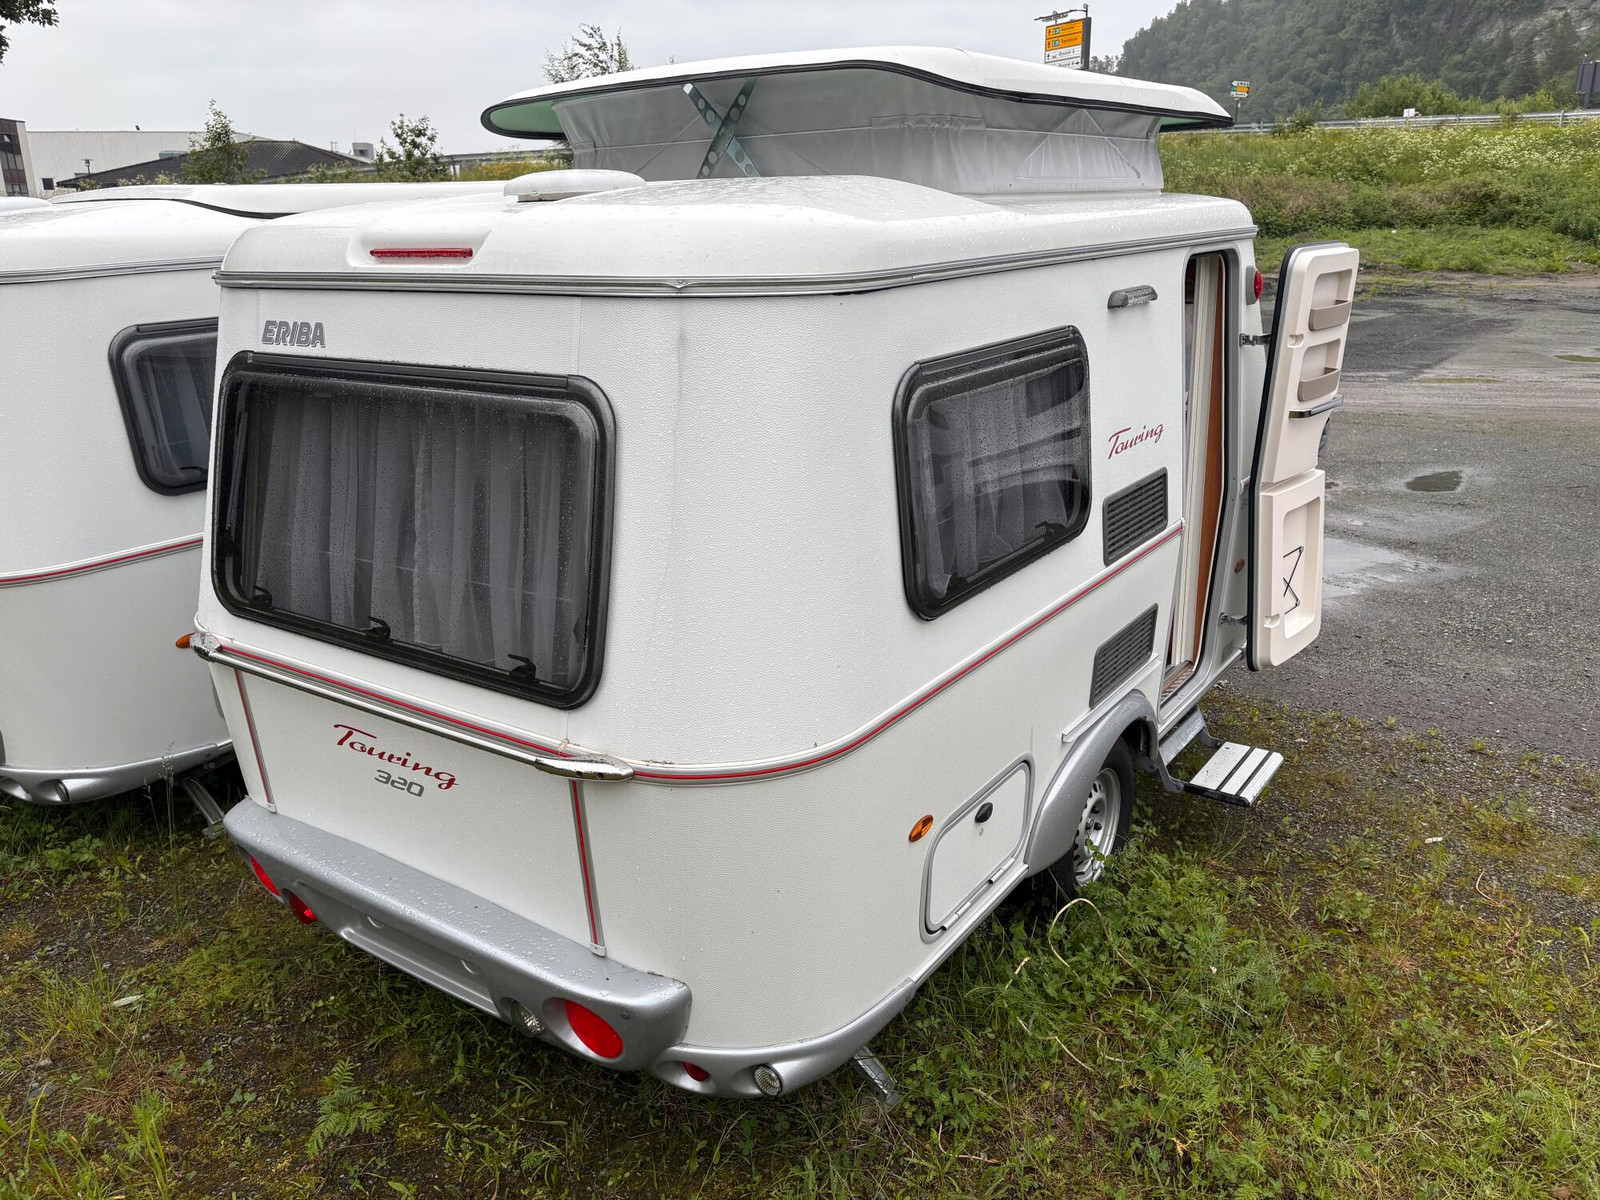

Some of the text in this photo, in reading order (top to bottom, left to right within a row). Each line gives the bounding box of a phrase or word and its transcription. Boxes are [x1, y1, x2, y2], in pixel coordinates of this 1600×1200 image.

[261, 320, 326, 348] ERIBA
[1108, 424, 1164, 459] Touring
[333, 724, 459, 790] Touring
[374, 769, 425, 798] 320
